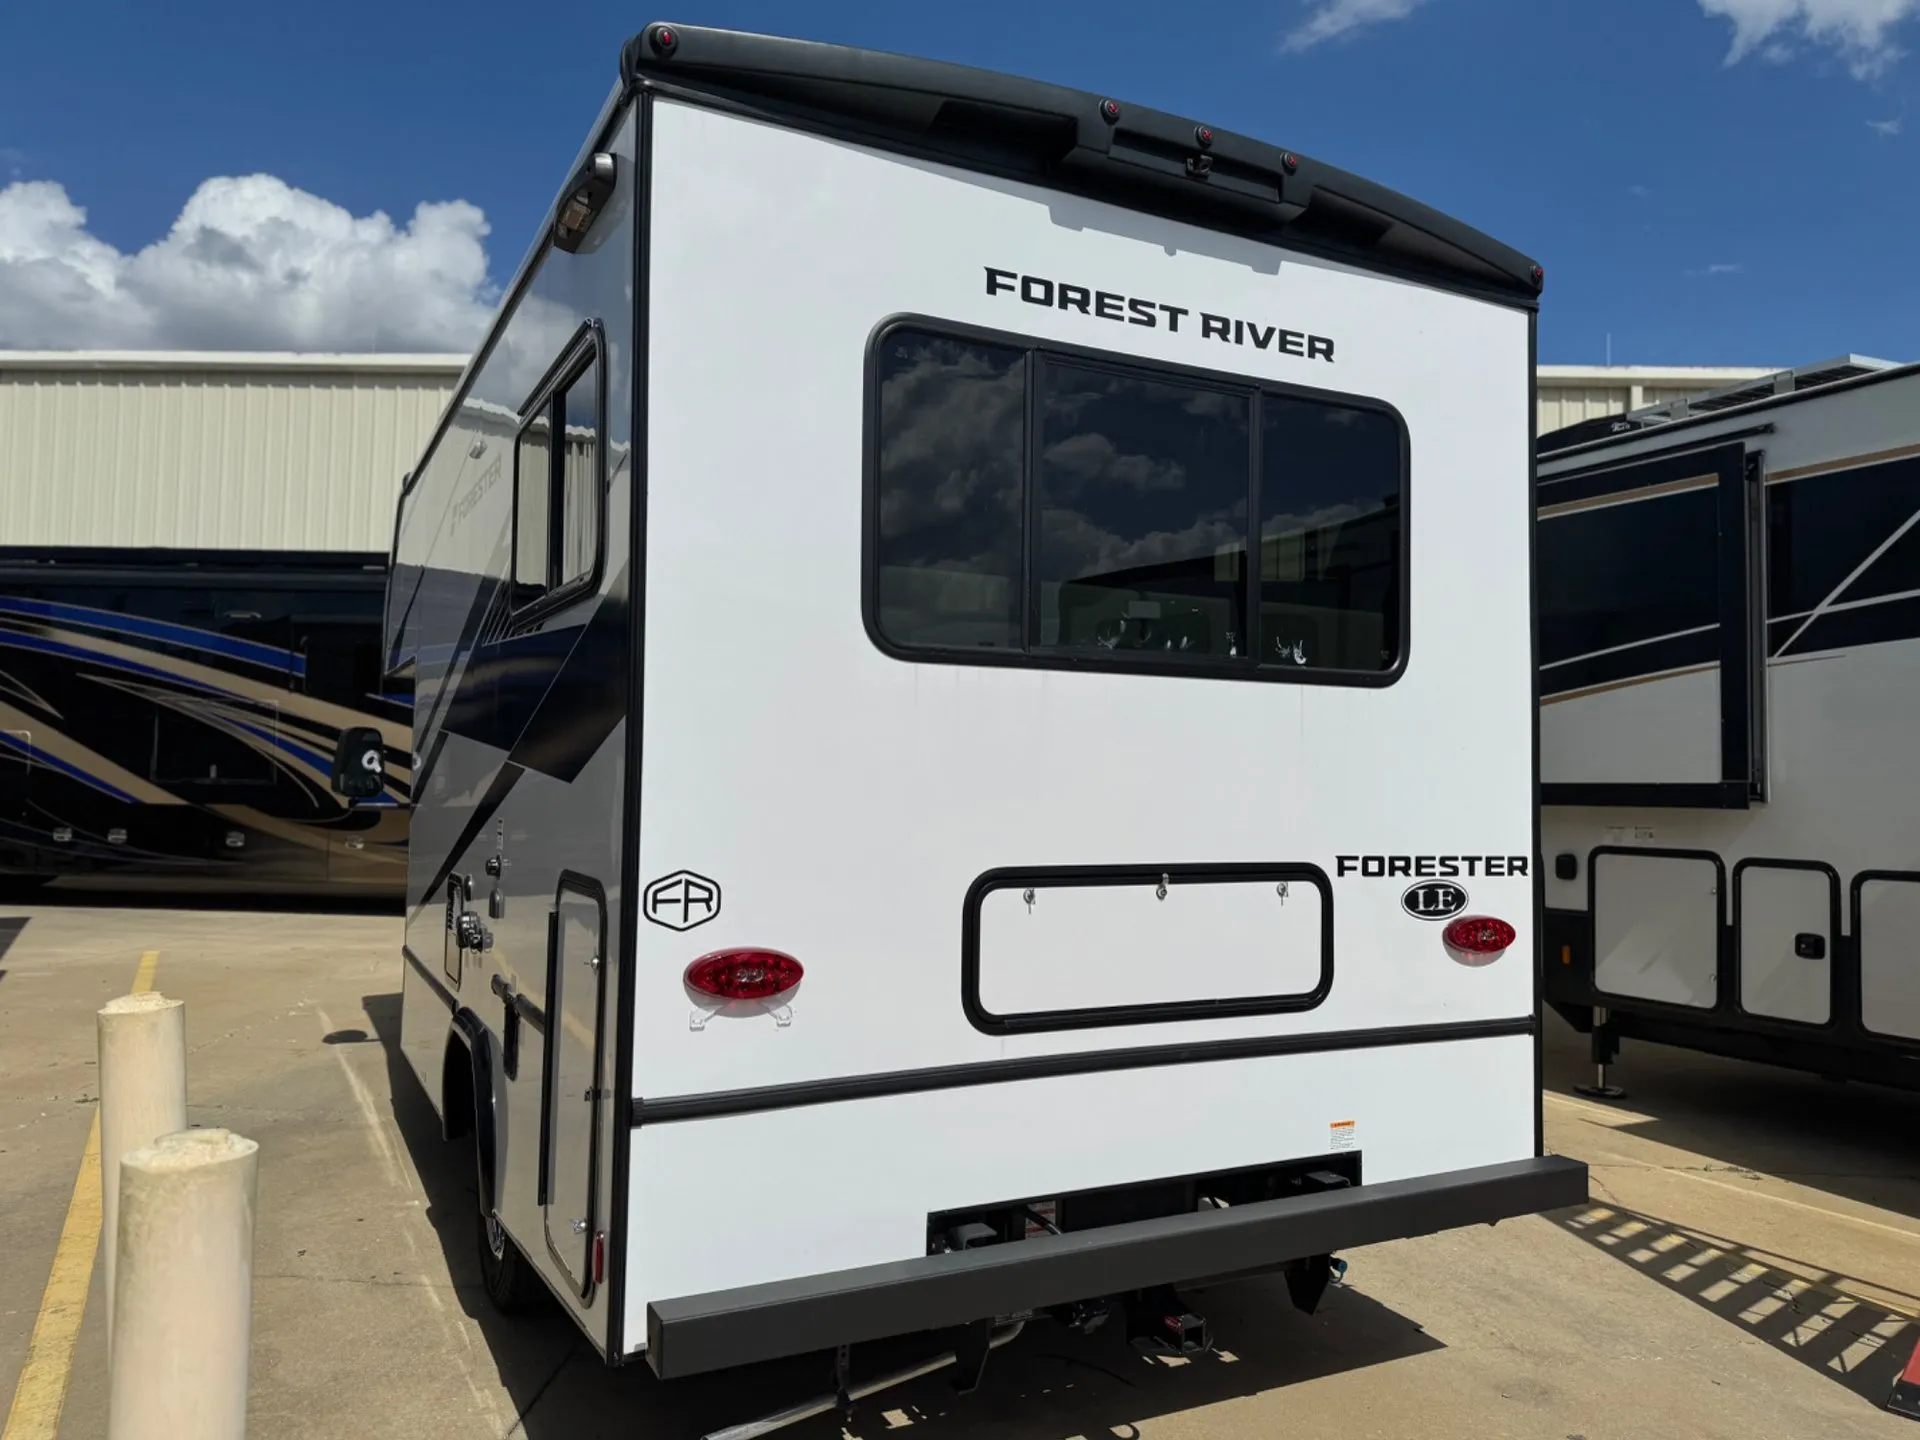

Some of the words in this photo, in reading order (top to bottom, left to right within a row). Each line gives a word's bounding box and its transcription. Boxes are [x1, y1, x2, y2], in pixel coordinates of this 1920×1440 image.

[984, 266, 1189, 333] FOREST
[1199, 312, 1335, 363] RIVER
[1335, 855, 1529, 878] FORESTER
[1415, 888, 1457, 911] LE
